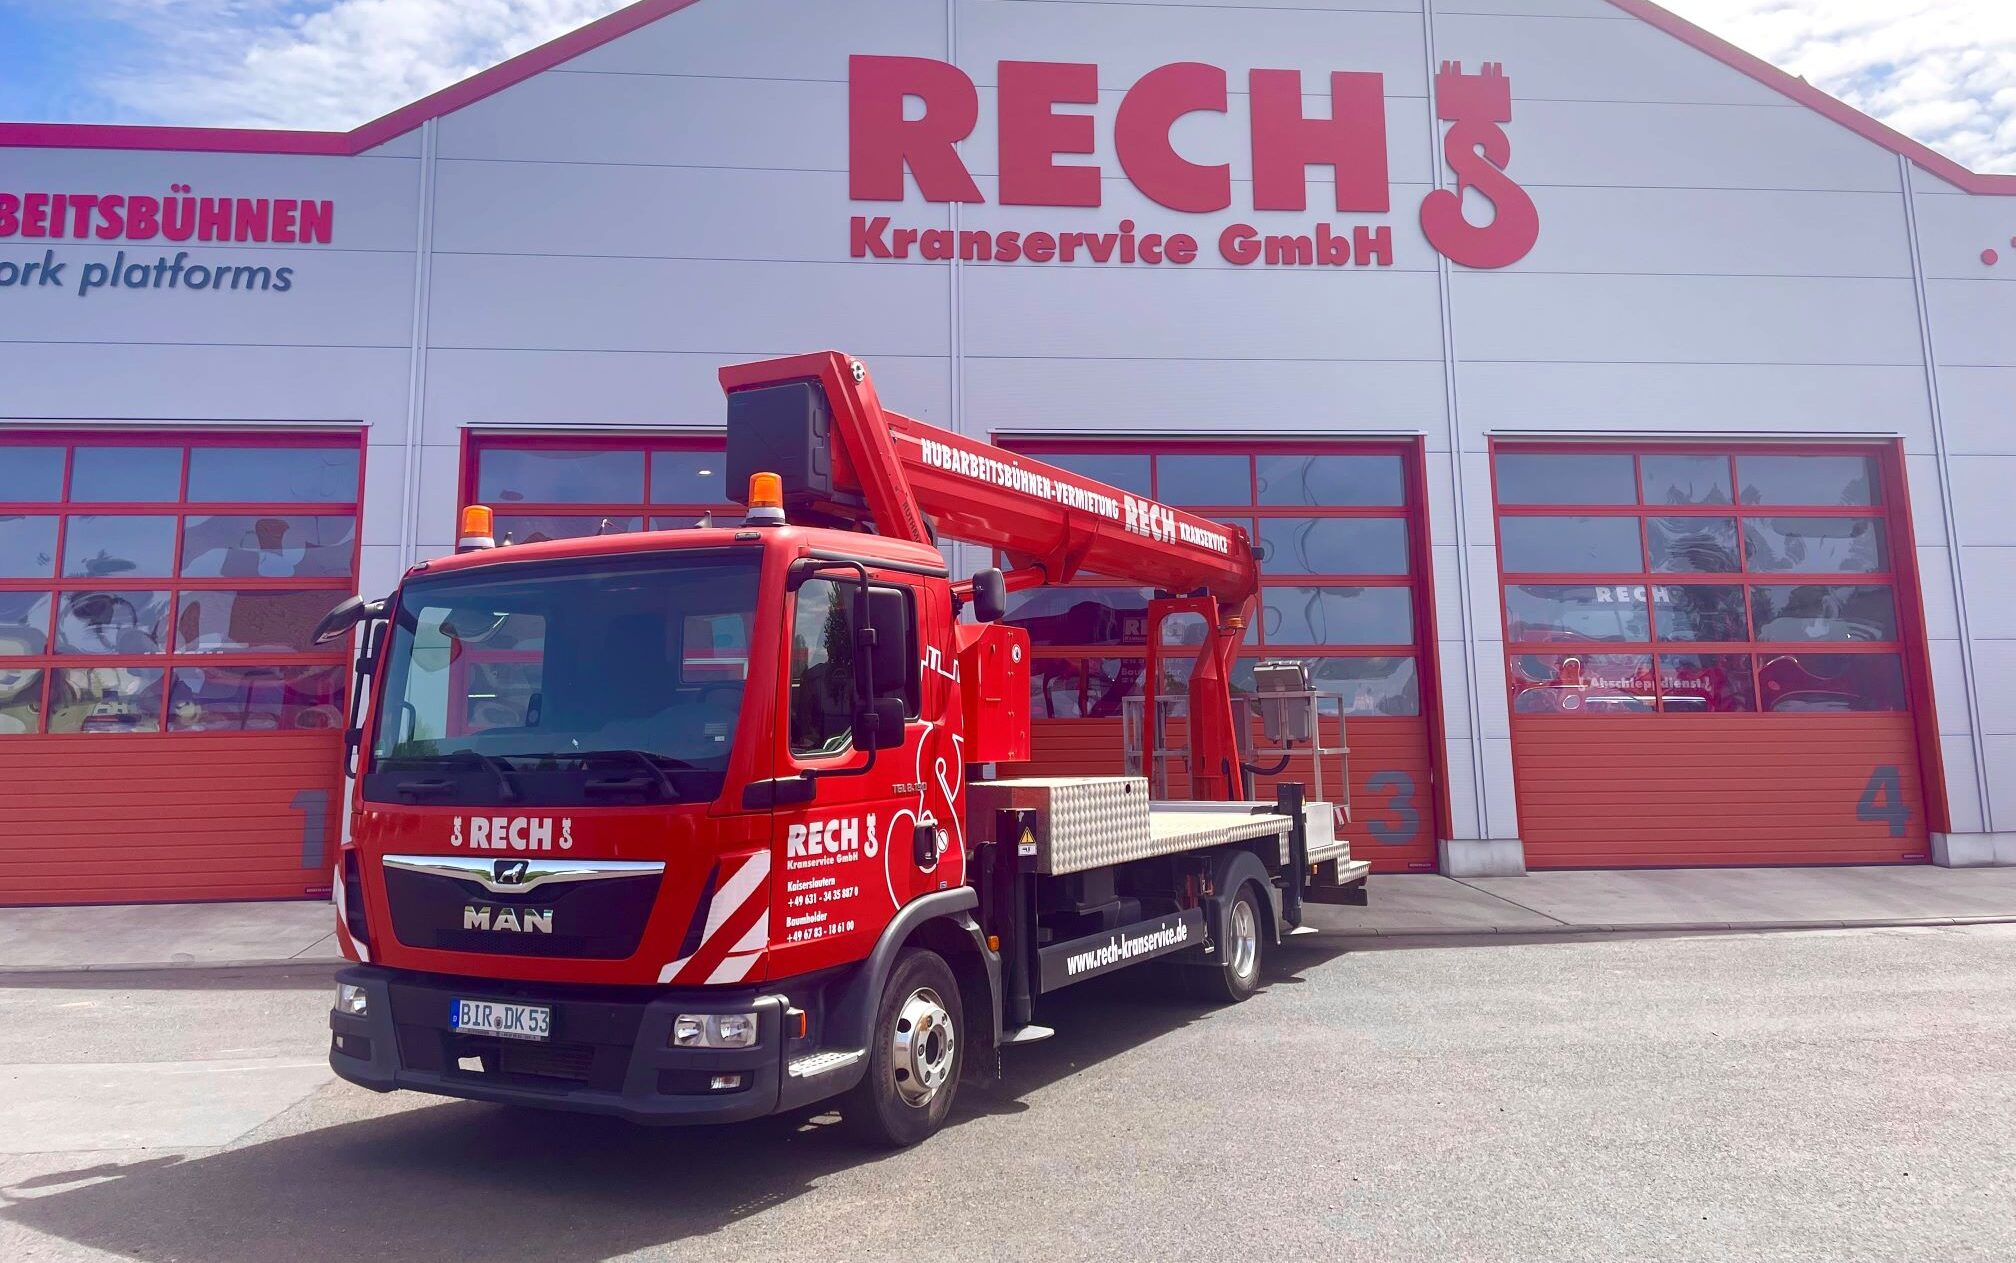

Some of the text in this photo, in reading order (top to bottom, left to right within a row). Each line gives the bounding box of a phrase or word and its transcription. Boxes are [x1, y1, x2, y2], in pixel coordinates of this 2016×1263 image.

[849, 54, 1390, 213] RECH
[0, 183, 334, 243] BEITSBÜHNEN
[850, 215, 1393, 266] Kranservice GmbH
[0, 249, 294, 297] ork platforms
[921, 437, 1228, 554] HUBARBEITSBÜHNEN-VERMIETUNG RECH KRANSERVICE
[1595, 586, 1670, 602] RECH
[1364, 768, 1420, 846] 3
[1855, 763, 1910, 837] 4
[289, 788, 329, 869] 1
[469, 816, 553, 850] RECH
[787, 817, 859, 858] RECH
[787, 852, 859, 870] Kranservice GmbH
[787, 877, 836, 892] Kaiserslautern
[788, 895, 803, 908] +49
[805, 893, 817, 905] 631
[823, 891, 832, 902] 34
[832, 889, 841, 900] 35
[463, 905, 554, 934] MAN
[786, 911, 828, 927] Baumholder
[787, 930, 802, 943] +49
[804, 928, 812, 940] 67
[814, 926, 823, 938] 83
[829, 924, 836, 935] 18
[837, 922, 845, 933] 61
[846, 920, 854, 931] 00
[1066, 917, 1187, 976] www.rech-kranservice.de
[461, 1003, 493, 1027] BIR
[504, 1007, 525, 1030] DK
[528, 1009, 549, 1033] 53
